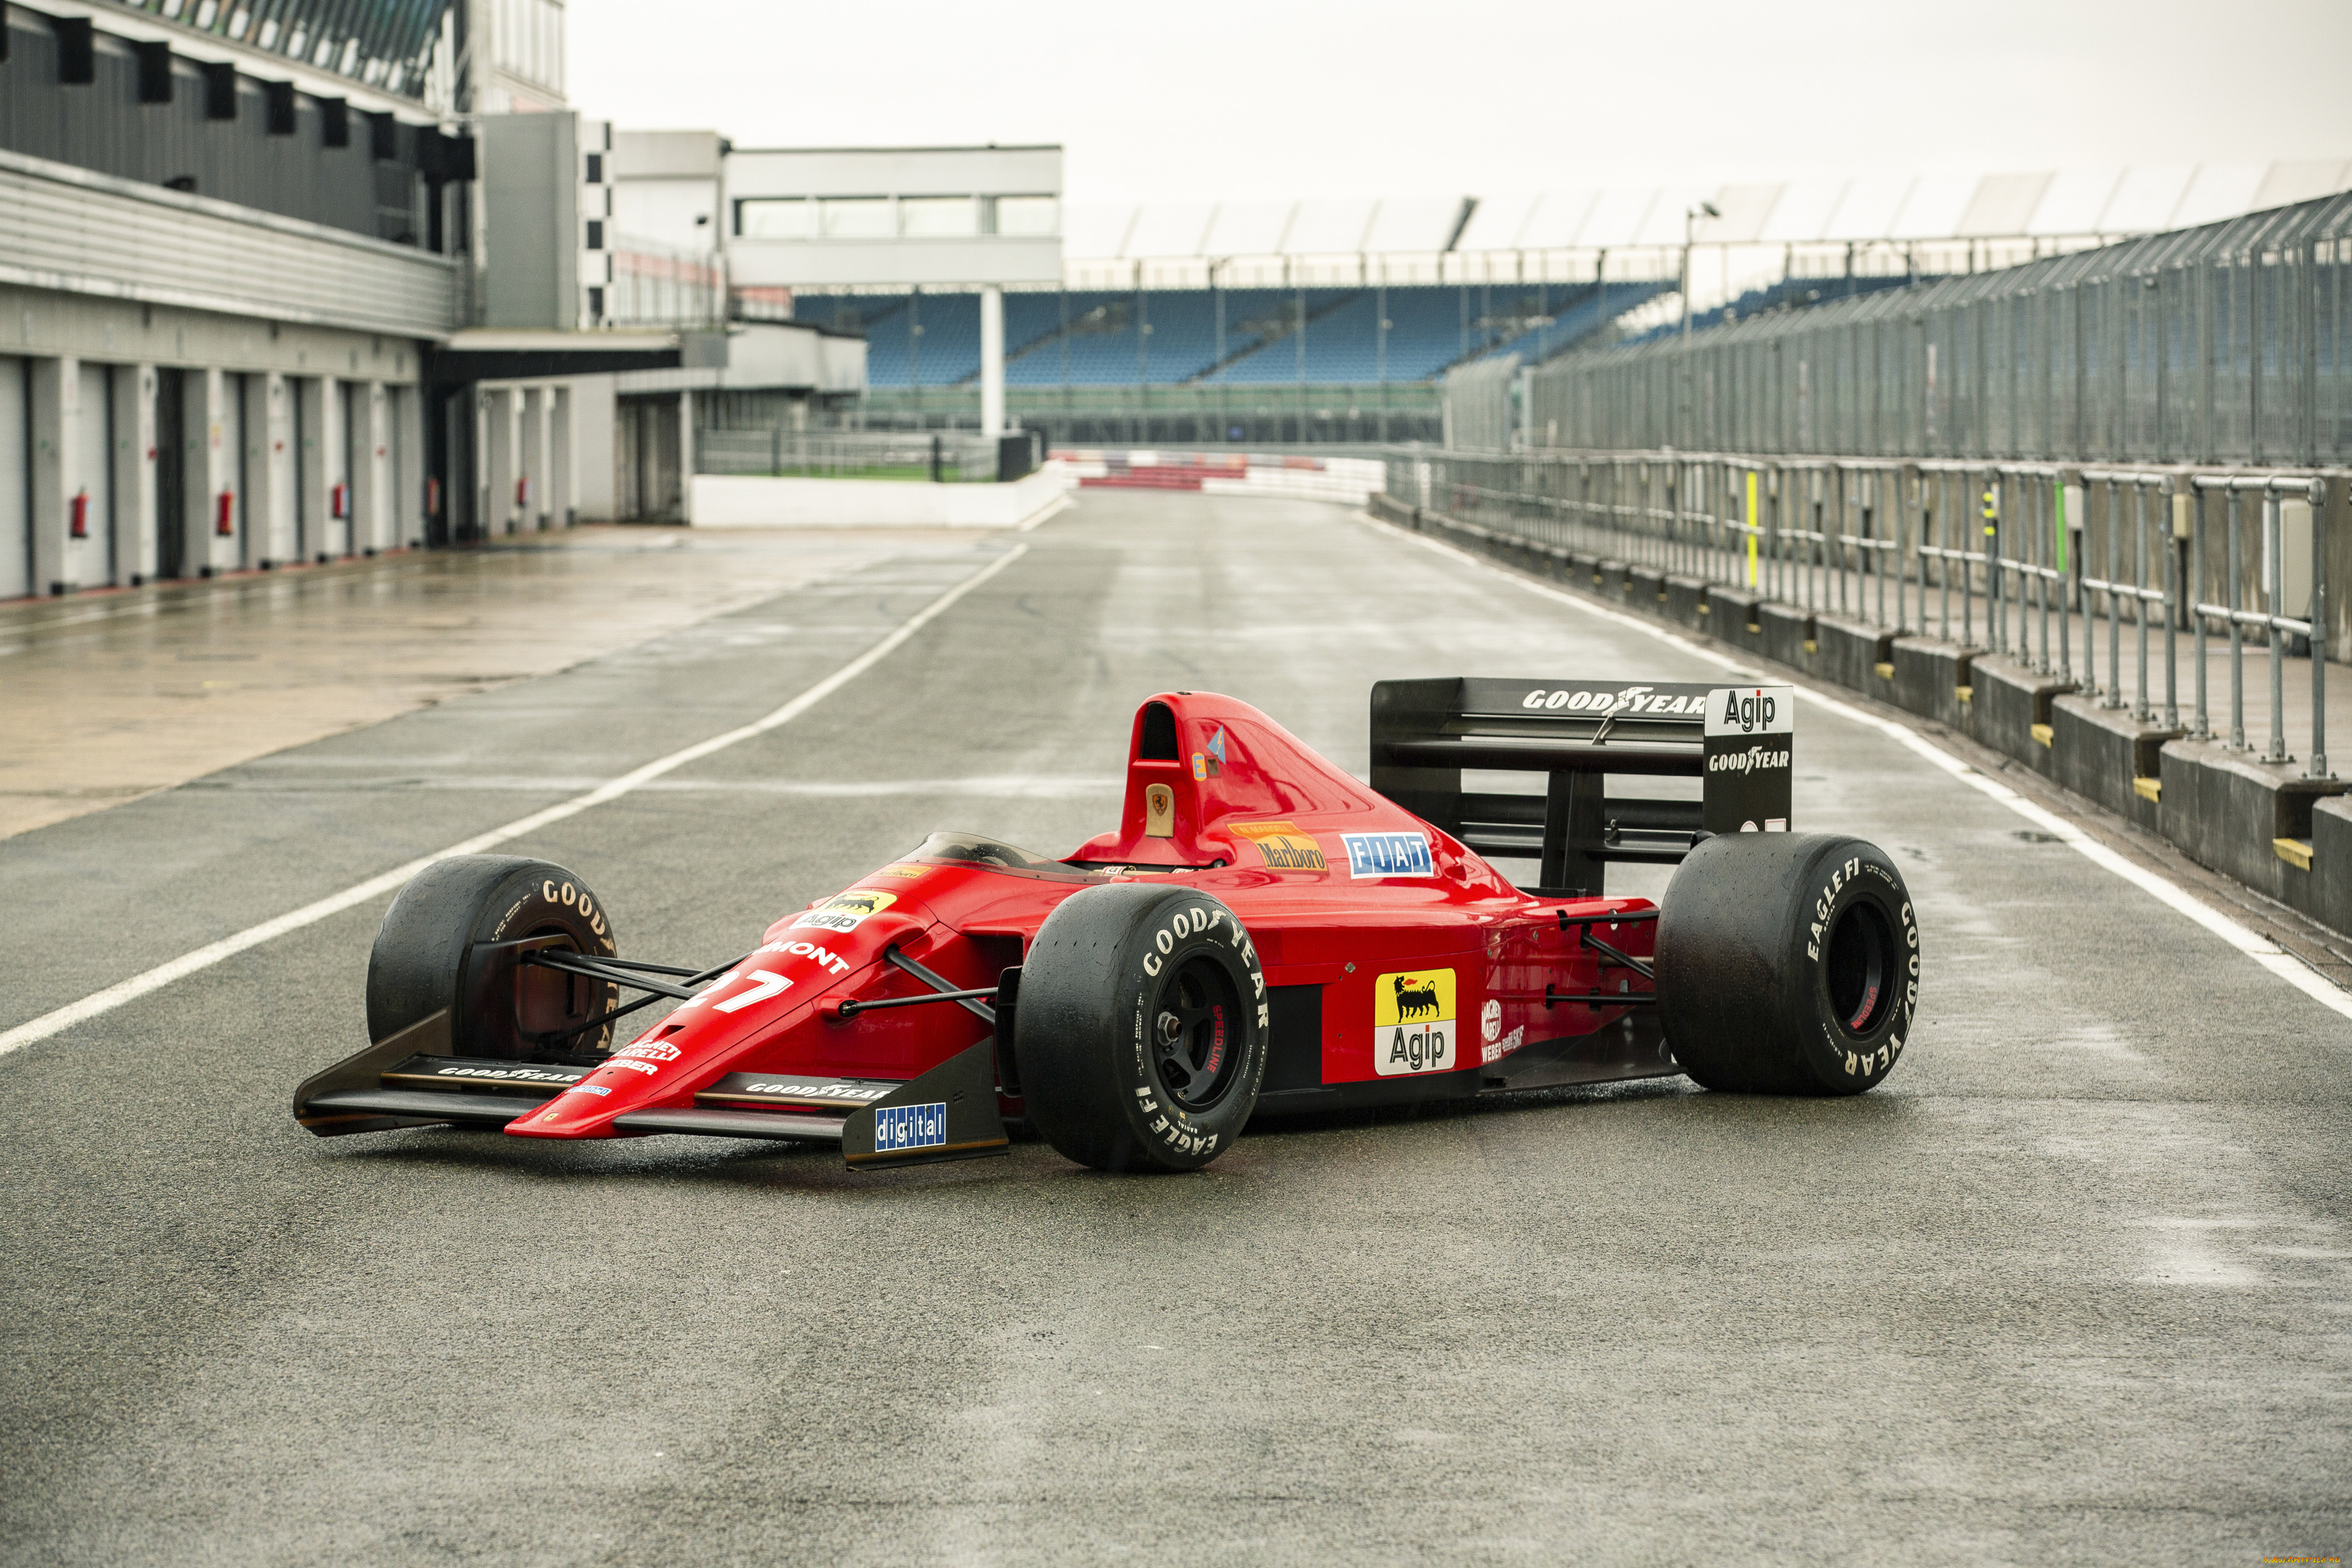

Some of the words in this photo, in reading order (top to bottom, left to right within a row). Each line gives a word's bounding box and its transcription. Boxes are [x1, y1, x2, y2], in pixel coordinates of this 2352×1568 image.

[1723, 690, 1775, 733] Agip
[1192, 755, 1207, 778] E
[1709, 746, 1789, 775] GOODYEAR
[1257, 836, 1324, 869] Marlboro
[1352, 841, 1425, 868] FIAT
[796, 914, 857, 928] Agip
[1808, 870, 1843, 962] EAGLE
[1143, 907, 1269, 1029] GOODYEAR
[673, 969, 794, 1013] 27
[1850, 986, 1877, 1029] SPEEDLINE
[1207, 1005, 1224, 1074] SPEEDLINE
[1482, 1042, 1502, 1063] WEBER
[437, 1067, 583, 1082] GOODYEAR
[877, 1113, 942, 1142] digital
[1149, 1114, 1218, 1156] EAGLE
[1178, 1121, 1198, 1134] RADIAL
